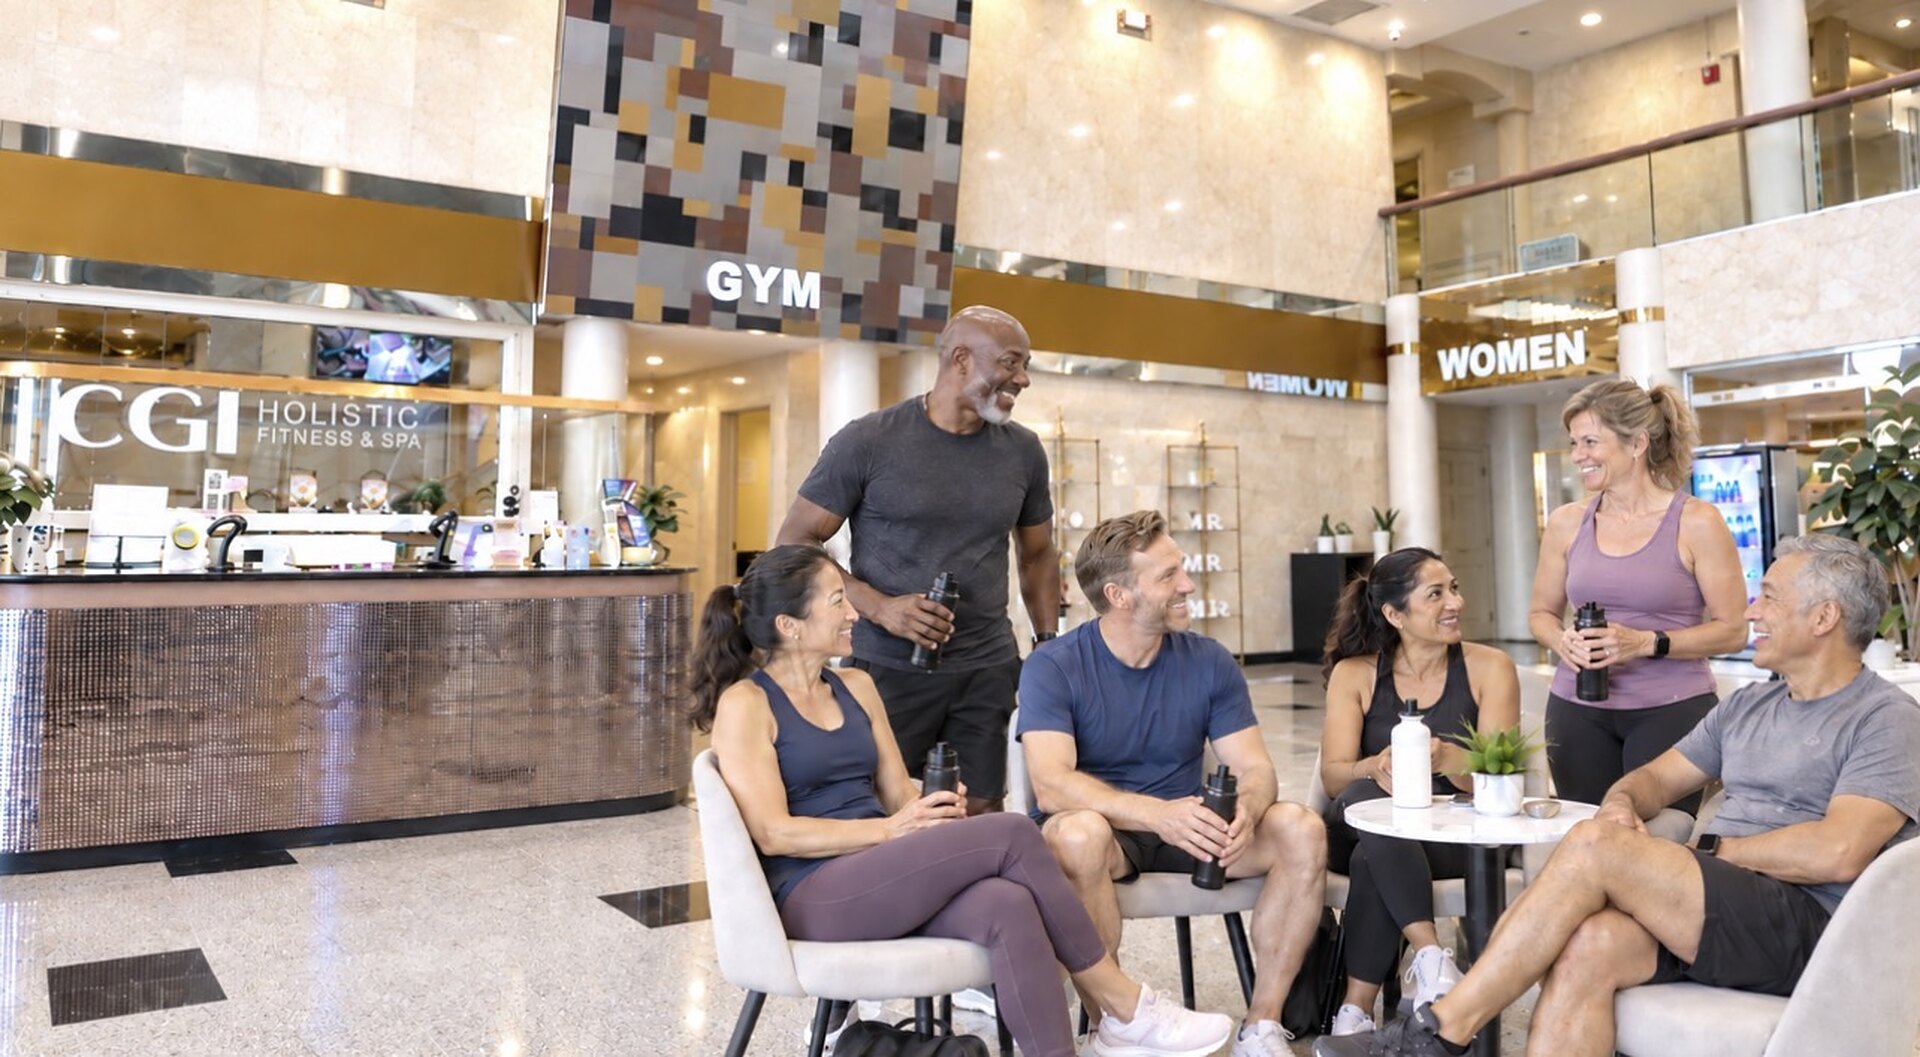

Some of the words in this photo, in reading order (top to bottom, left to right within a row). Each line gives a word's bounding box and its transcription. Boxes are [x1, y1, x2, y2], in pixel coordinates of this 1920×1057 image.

[706, 260, 821, 309] GYM
[1437, 329, 1586, 381] WOMEN
[56, 383, 240, 455] CGI
[258, 398, 419, 430] HOLISTIC
[257, 427, 353, 447] FITNESS
[360, 431, 374, 449] &
[381, 432, 422, 450] SPA
[1183, 553, 1223, 573] MR
